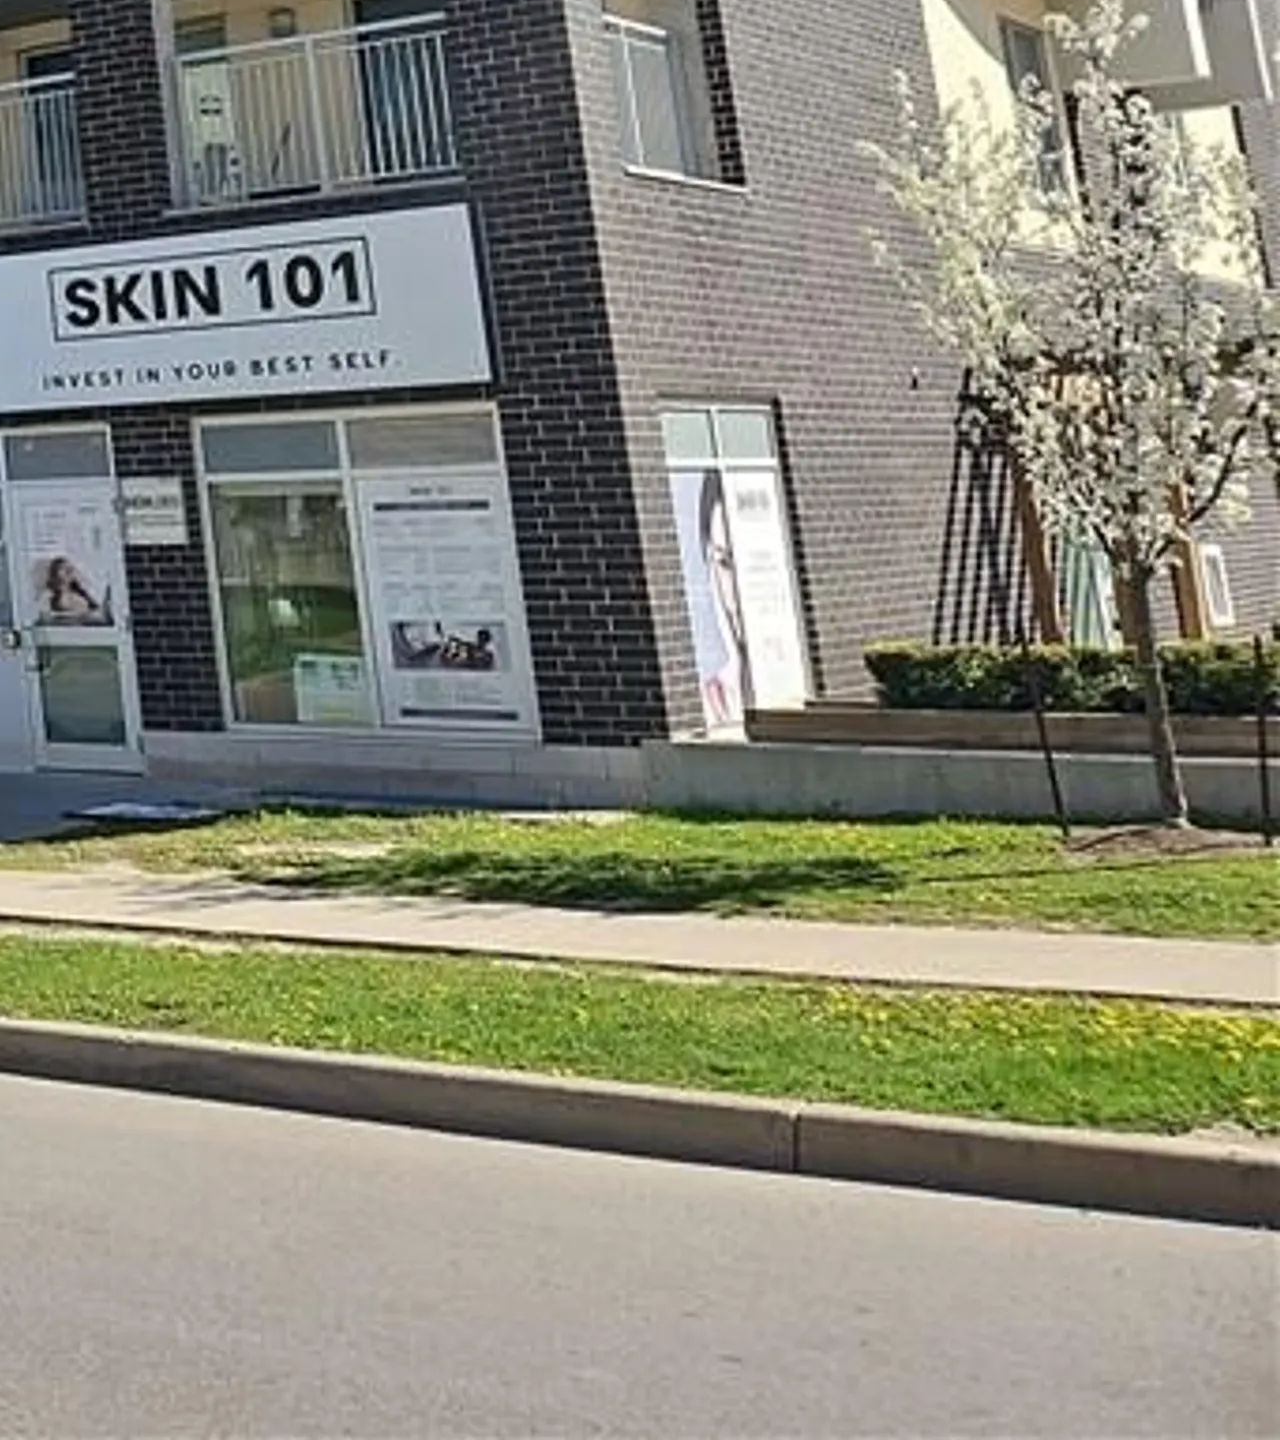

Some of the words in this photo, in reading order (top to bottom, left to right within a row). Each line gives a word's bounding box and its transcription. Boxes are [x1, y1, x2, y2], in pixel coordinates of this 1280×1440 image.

[64, 265, 221, 327] SKIN
[245, 251, 360, 311] 101
[42, 369, 126, 392] INVEST
[137, 366, 162, 384] IN
[173, 359, 237, 383] YOUR
[251, 355, 315, 378] BEST
